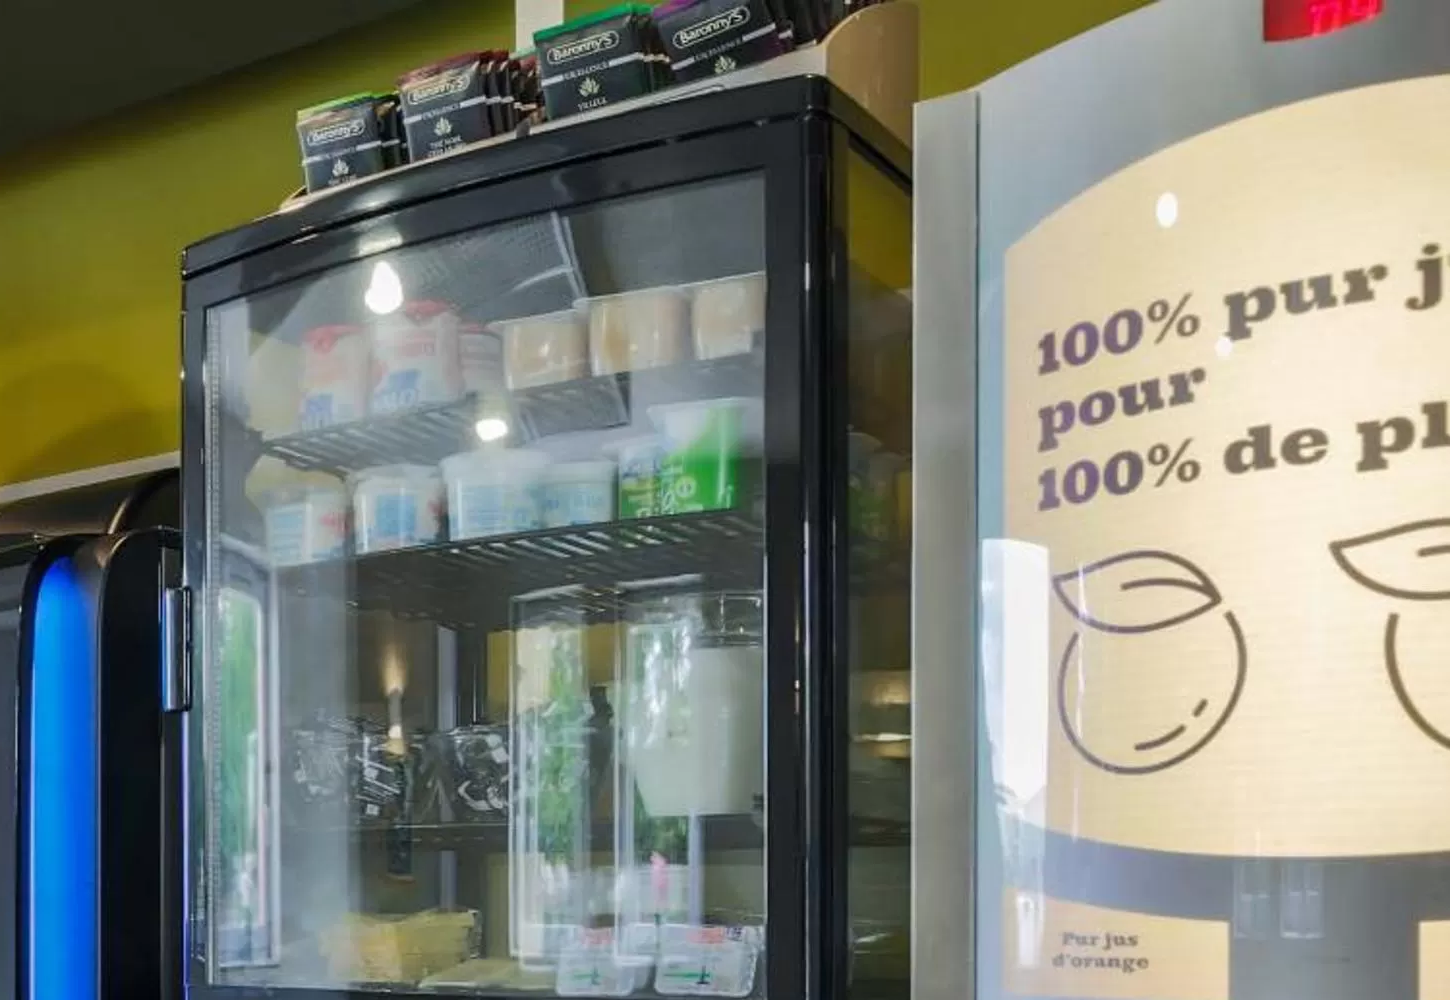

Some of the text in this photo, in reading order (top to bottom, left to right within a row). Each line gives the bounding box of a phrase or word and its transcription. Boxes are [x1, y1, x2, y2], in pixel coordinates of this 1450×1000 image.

[1038, 243, 1450, 376] 100% pur j
[1038, 368, 1206, 451] pour
[1038, 438, 1201, 511] 100%
[1223, 425, 1328, 475] de
[1051, 952, 1149, 973] d'orange
[1061, 931, 1139, 951] Pur jus
